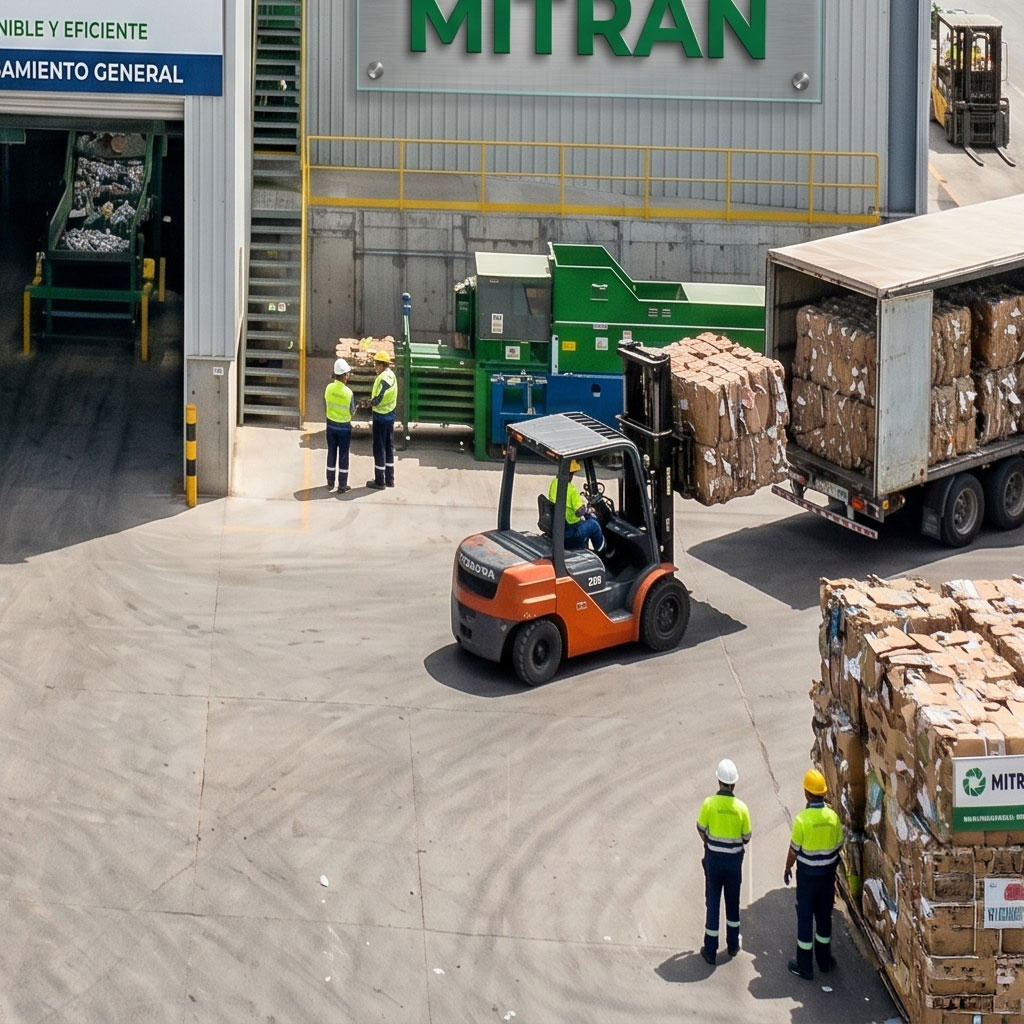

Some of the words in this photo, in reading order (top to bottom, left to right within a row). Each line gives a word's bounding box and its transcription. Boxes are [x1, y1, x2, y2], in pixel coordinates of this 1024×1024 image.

[49, 22, 59, 37] Y
[64, 22, 148, 40] EFICIENTE
[94, 63, 184, 85] GENERAL
